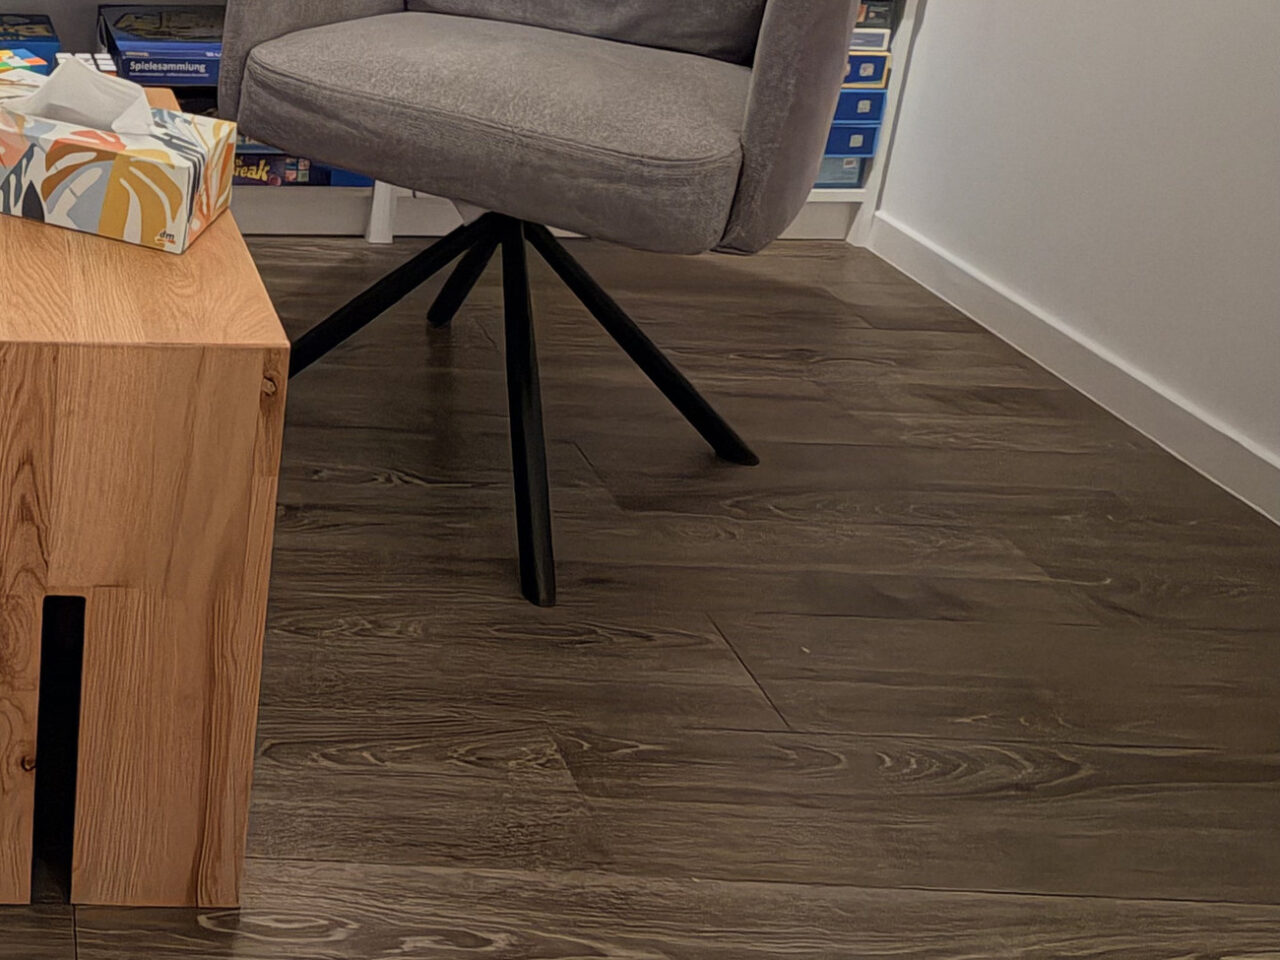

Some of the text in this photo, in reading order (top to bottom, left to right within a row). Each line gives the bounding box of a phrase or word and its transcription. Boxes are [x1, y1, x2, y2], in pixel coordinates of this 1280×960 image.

[129, 61, 206, 72] Spielesammlung
[233, 159, 270, 181] reak
[159, 230, 174, 239] dm
